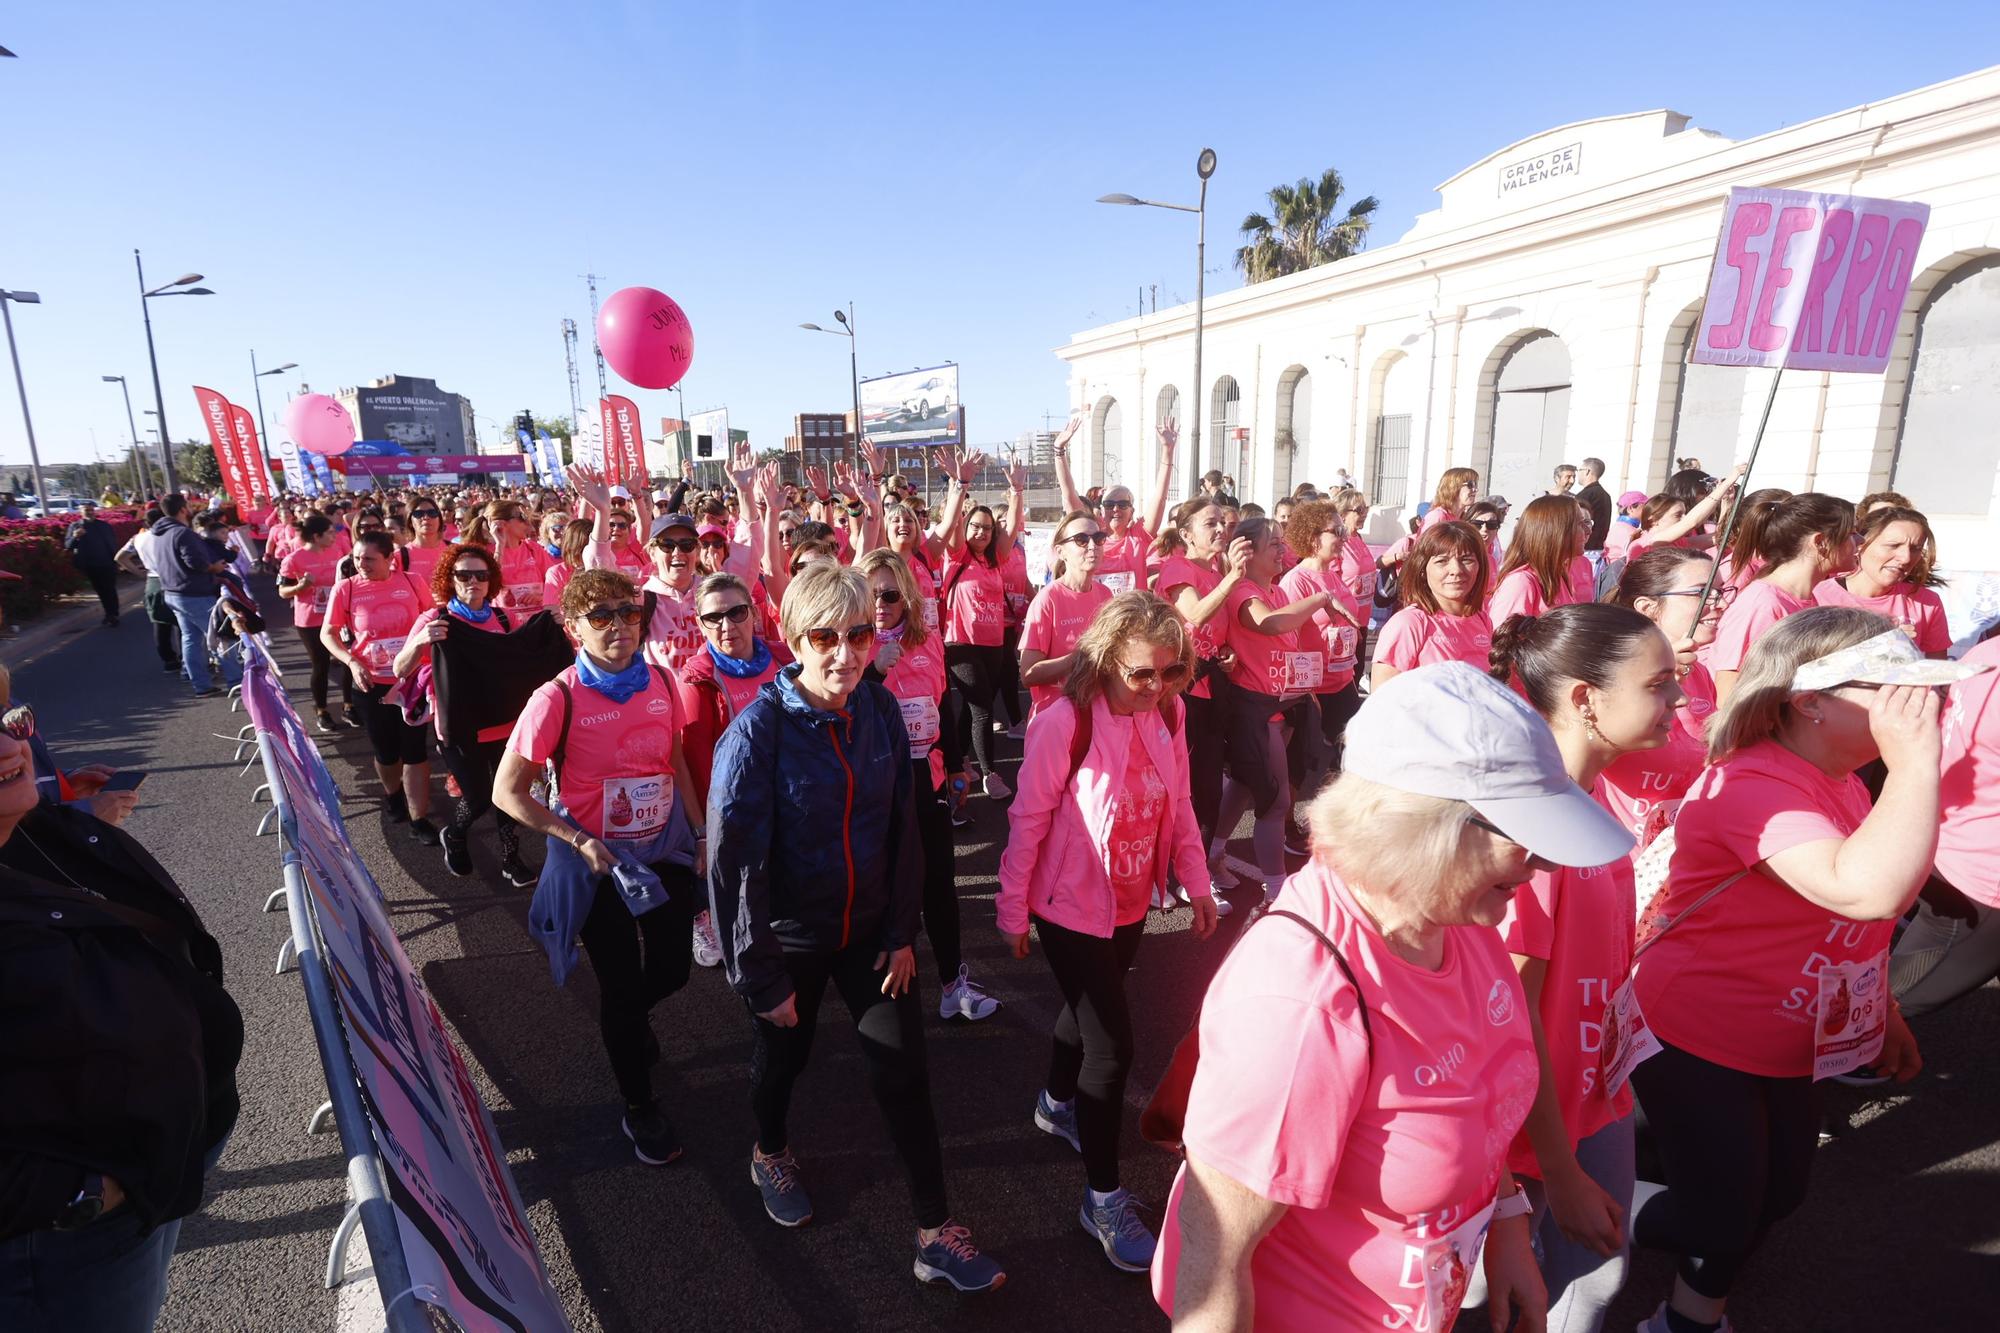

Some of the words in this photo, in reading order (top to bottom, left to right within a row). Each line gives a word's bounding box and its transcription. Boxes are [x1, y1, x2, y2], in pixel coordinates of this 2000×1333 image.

[1507, 160, 1545, 179] GRAO
[1552, 149, 1573, 165] DE
[1503, 161, 1574, 192] VALENCIA
[1707, 202, 1923, 359] SERRA
[1270, 650, 1285, 662] TU
[1295, 671, 1309, 681] 016
[580, 710, 621, 728] OYSHO
[907, 721, 922, 732] 16
[1641, 771, 1673, 791] TU
[636, 804, 658, 819] 016
[1825, 918, 1868, 948] TU
[1819, 1057, 1848, 1070] OYSHO
